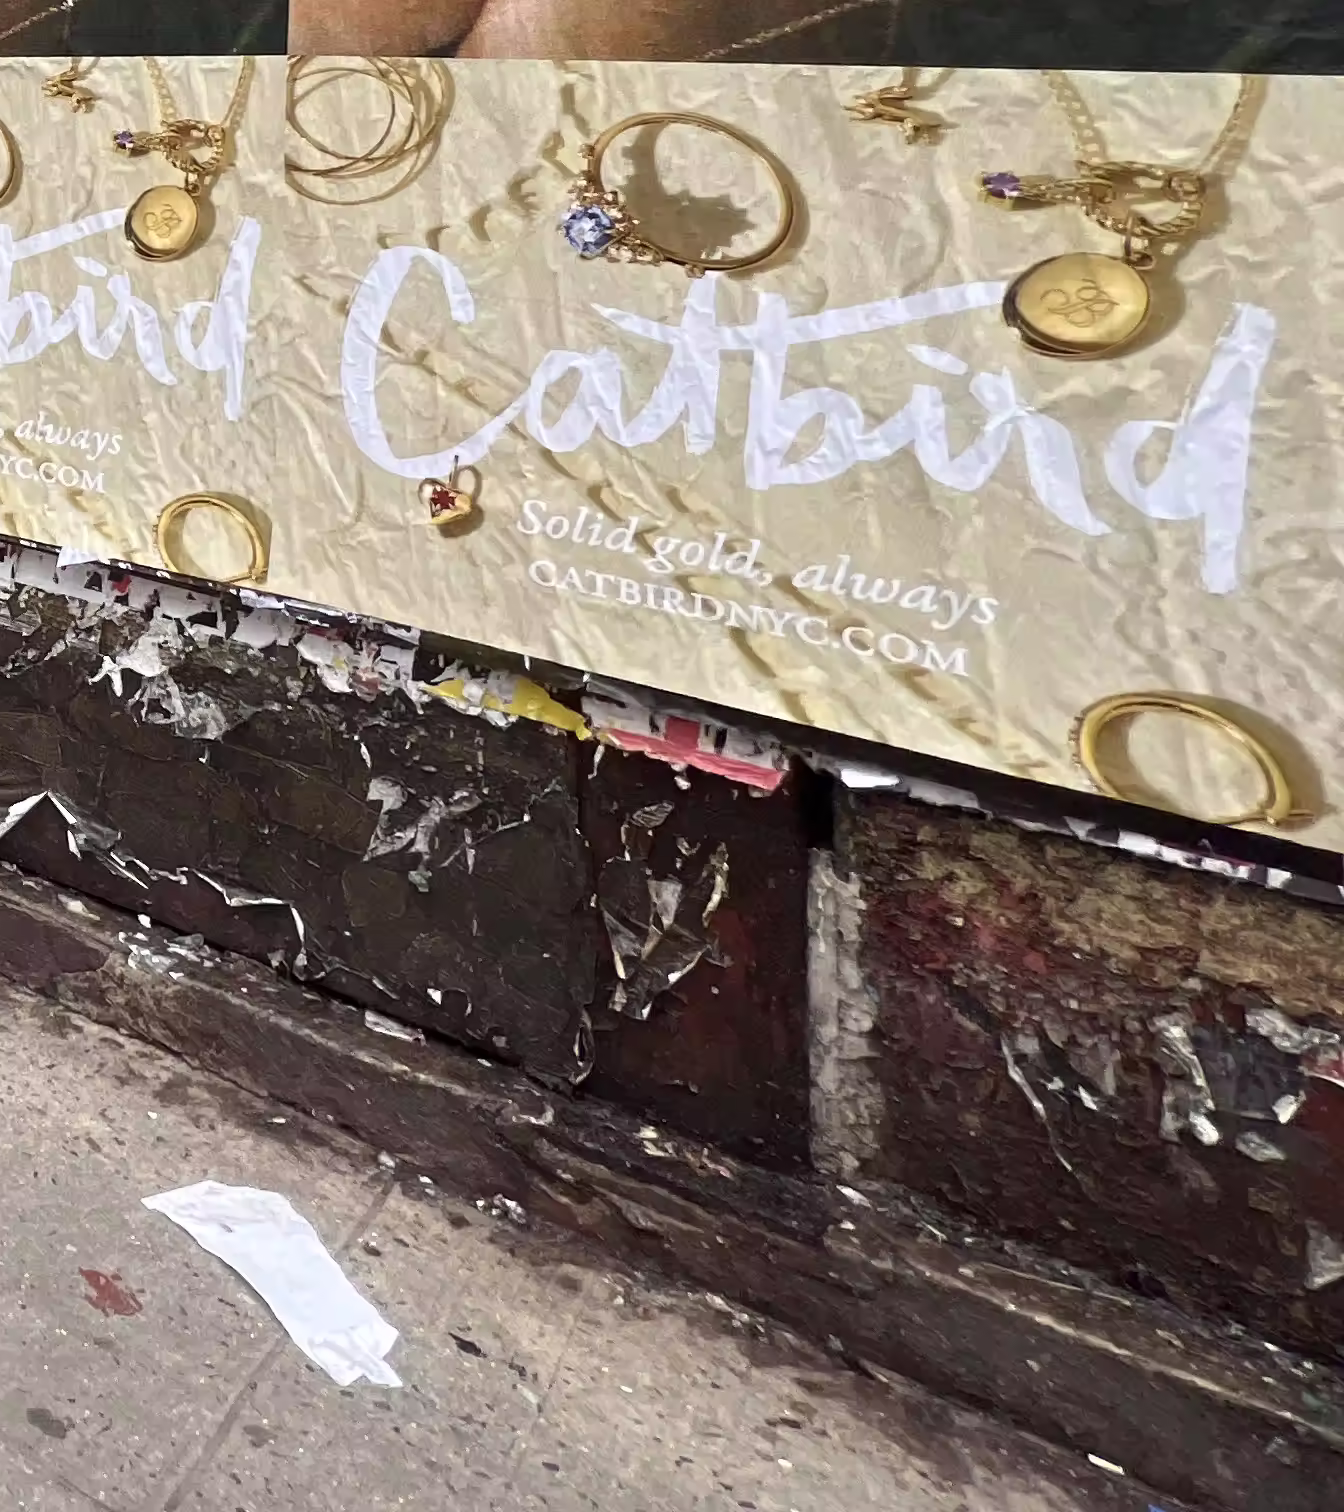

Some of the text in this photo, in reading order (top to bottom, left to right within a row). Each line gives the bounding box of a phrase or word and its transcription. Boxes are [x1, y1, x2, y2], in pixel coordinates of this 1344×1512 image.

[14, 411, 124, 461] always
[340, 246, 1276, 594] Catbird
[516, 499, 1000, 631] Solid gold, always
[528, 559, 971, 677] CATBIRDNYC.COM
